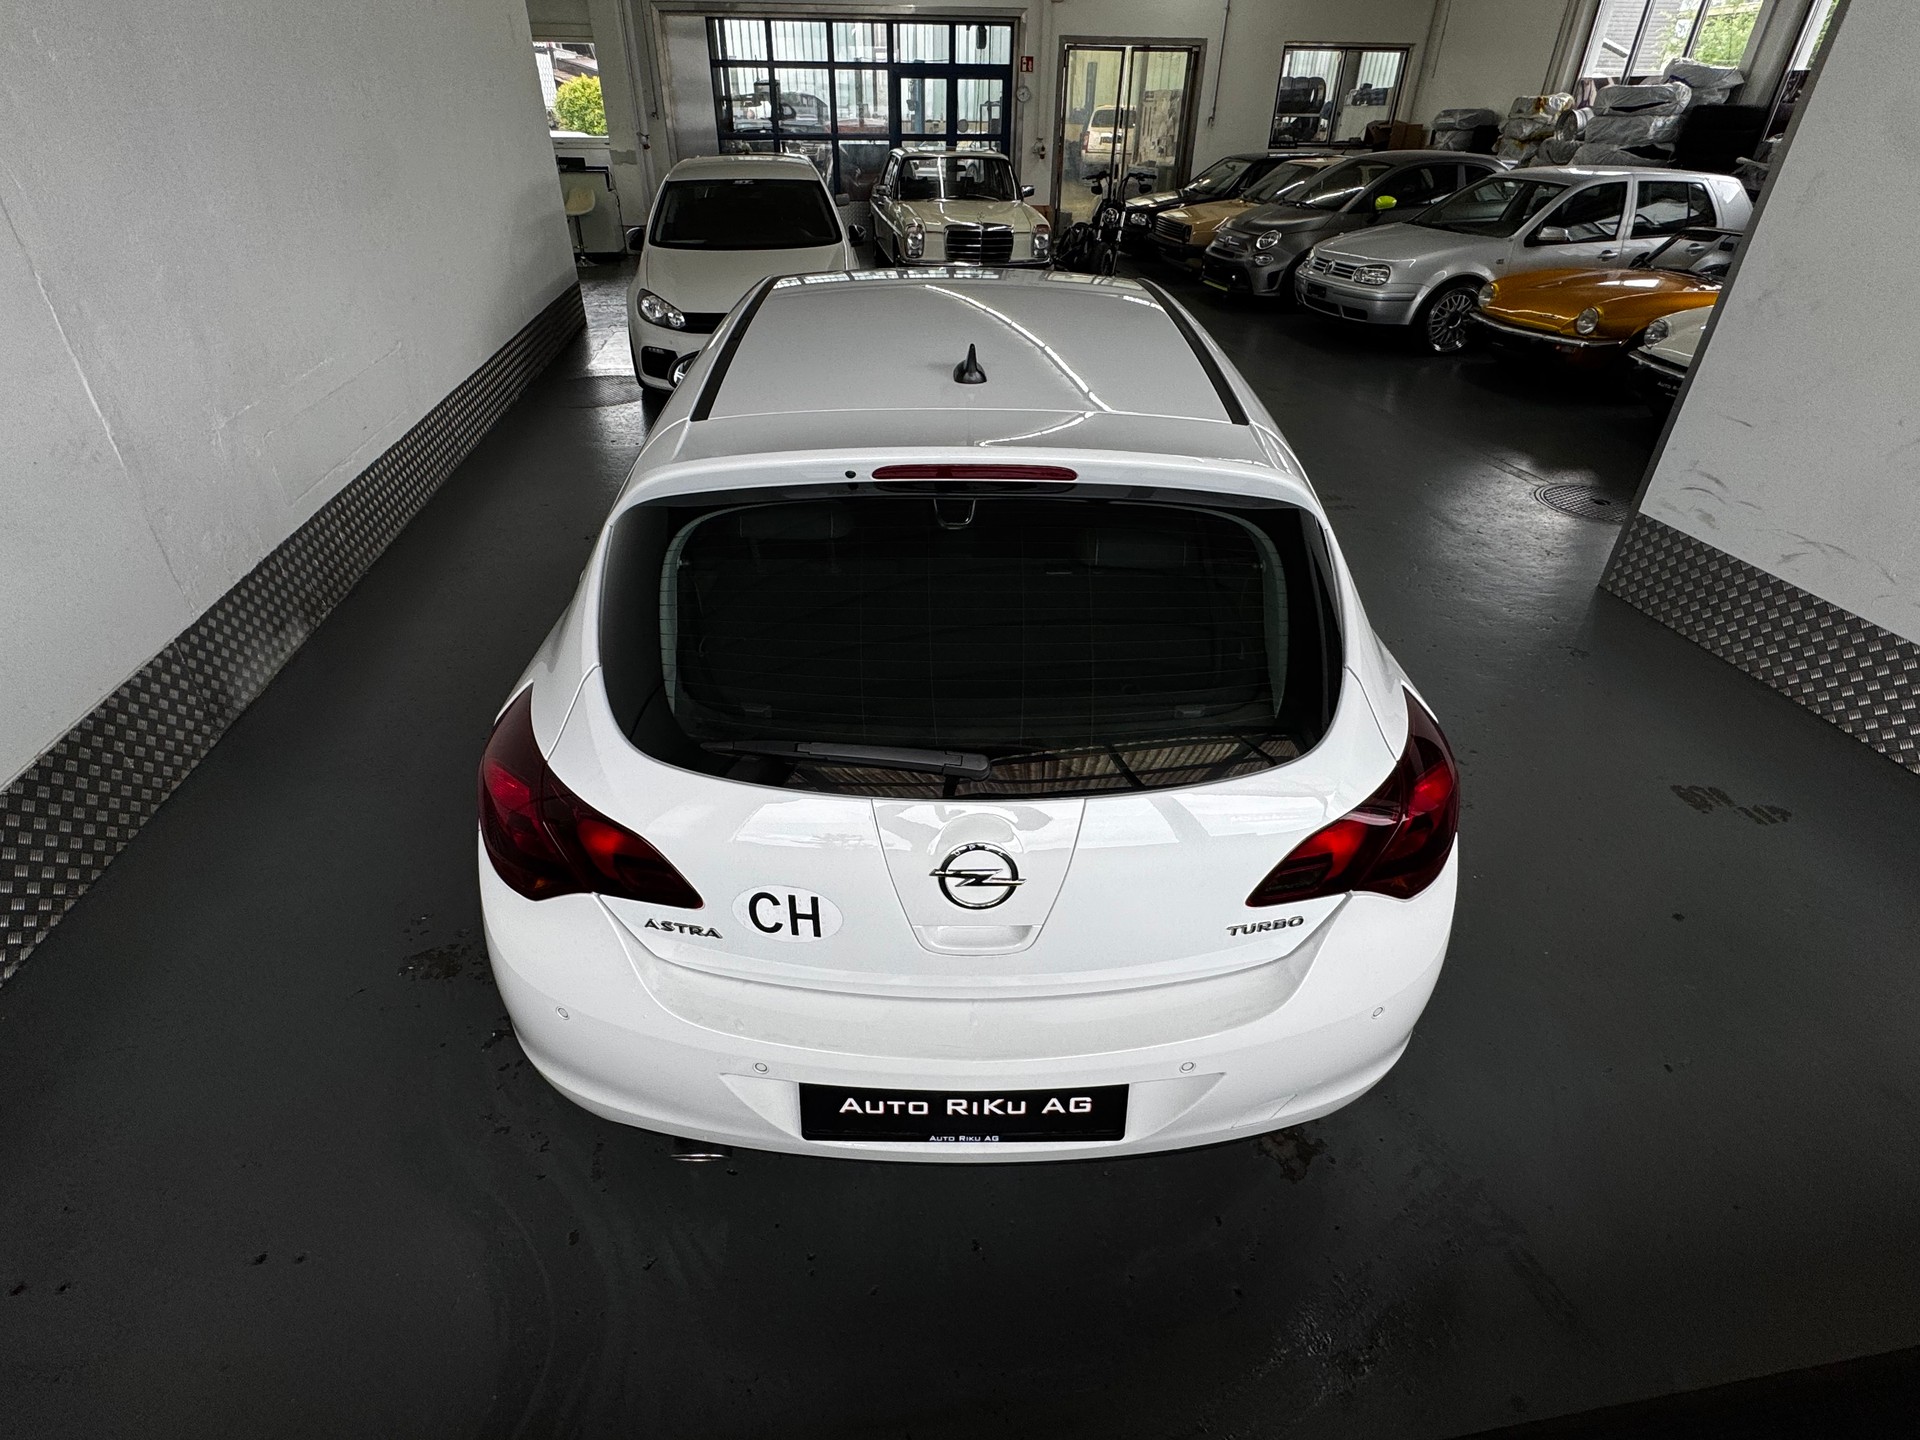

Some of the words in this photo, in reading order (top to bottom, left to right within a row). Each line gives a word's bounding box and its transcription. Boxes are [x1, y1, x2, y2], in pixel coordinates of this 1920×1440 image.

[748, 891, 822, 938] CH
[644, 918, 723, 939] ASTRA
[1226, 915, 1304, 936] TURBO
[1041, 1097, 1093, 1114] AG
